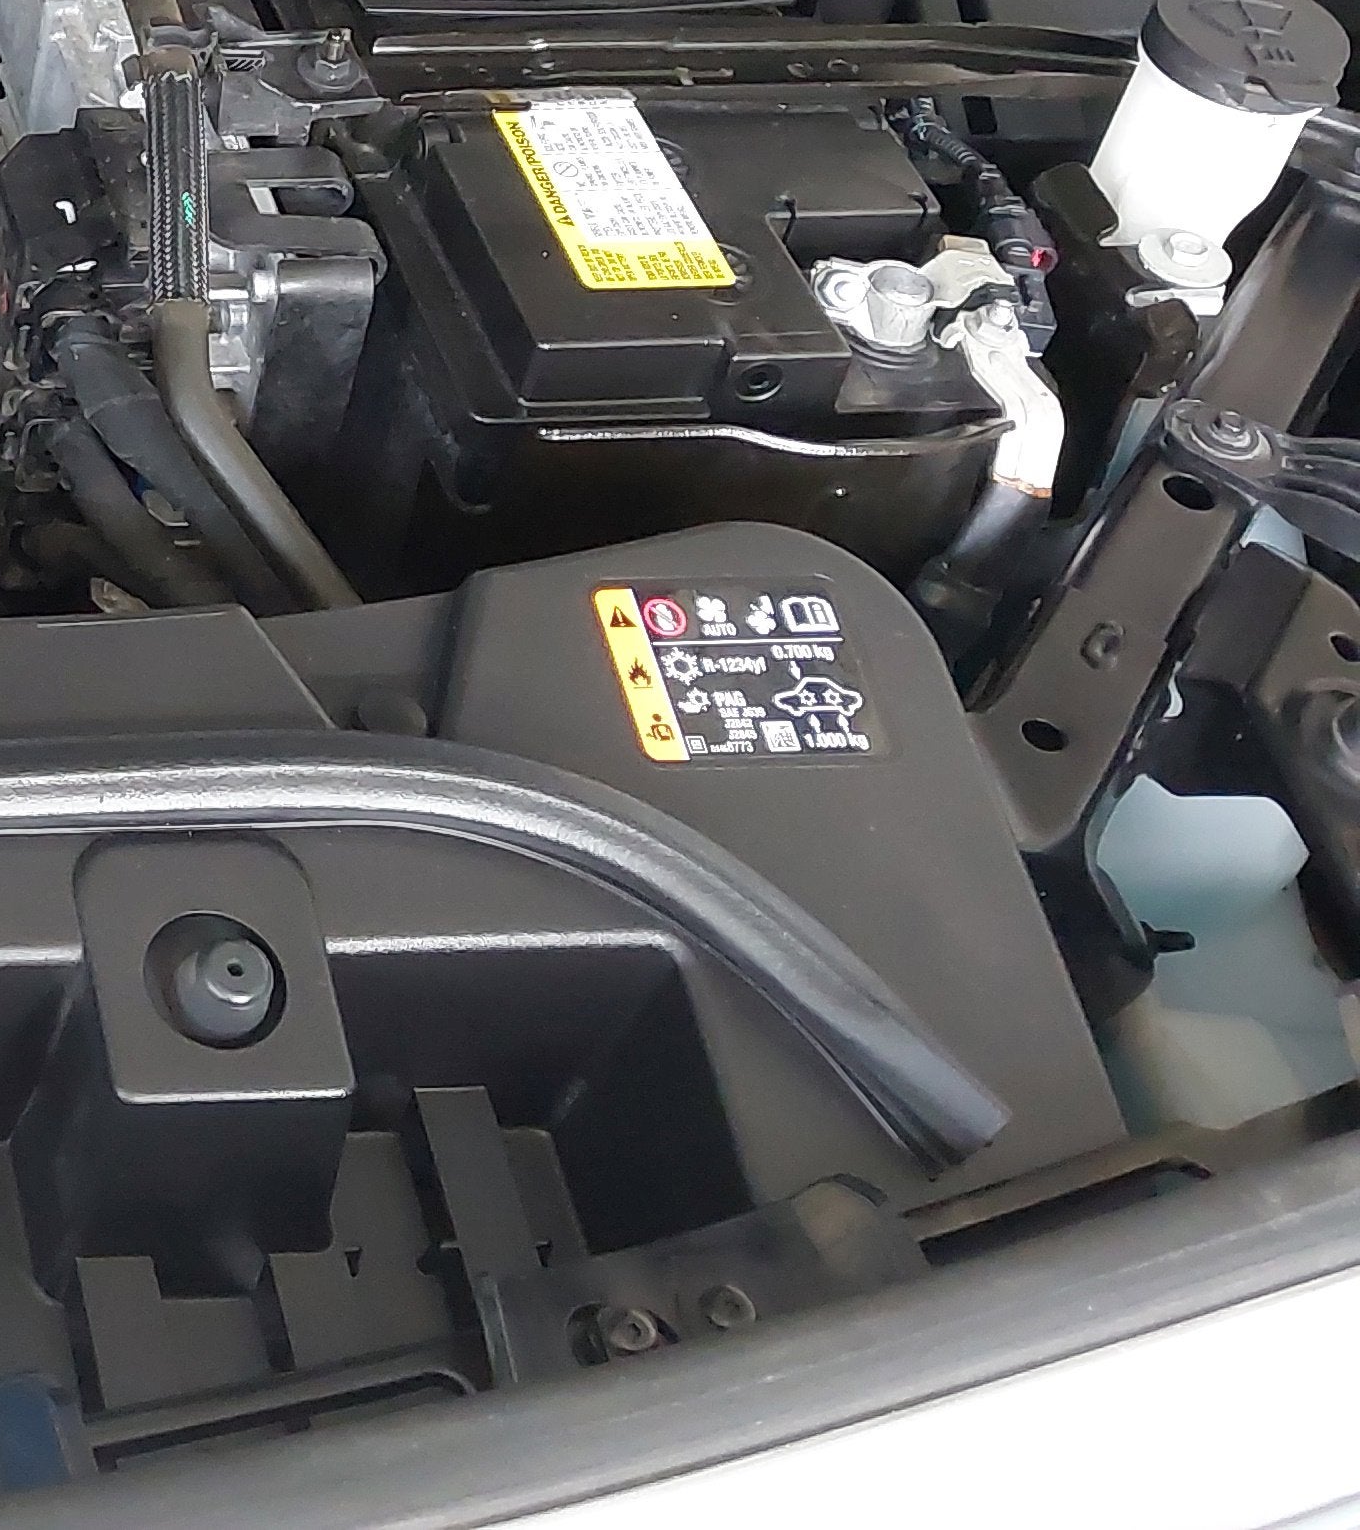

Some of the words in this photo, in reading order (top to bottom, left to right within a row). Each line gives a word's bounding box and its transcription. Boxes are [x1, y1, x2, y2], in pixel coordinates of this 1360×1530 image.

[702, 622, 737, 637] AUTO
[770, 644, 812, 660] 0.700
[813, 645, 835, 661] kg
[702, 655, 767, 676] R-1234yf
[712, 690, 747, 707] PAG
[718, 708, 740, 718] SAE
[804, 732, 847, 749] 1.000
[847, 732, 870, 751] kg
